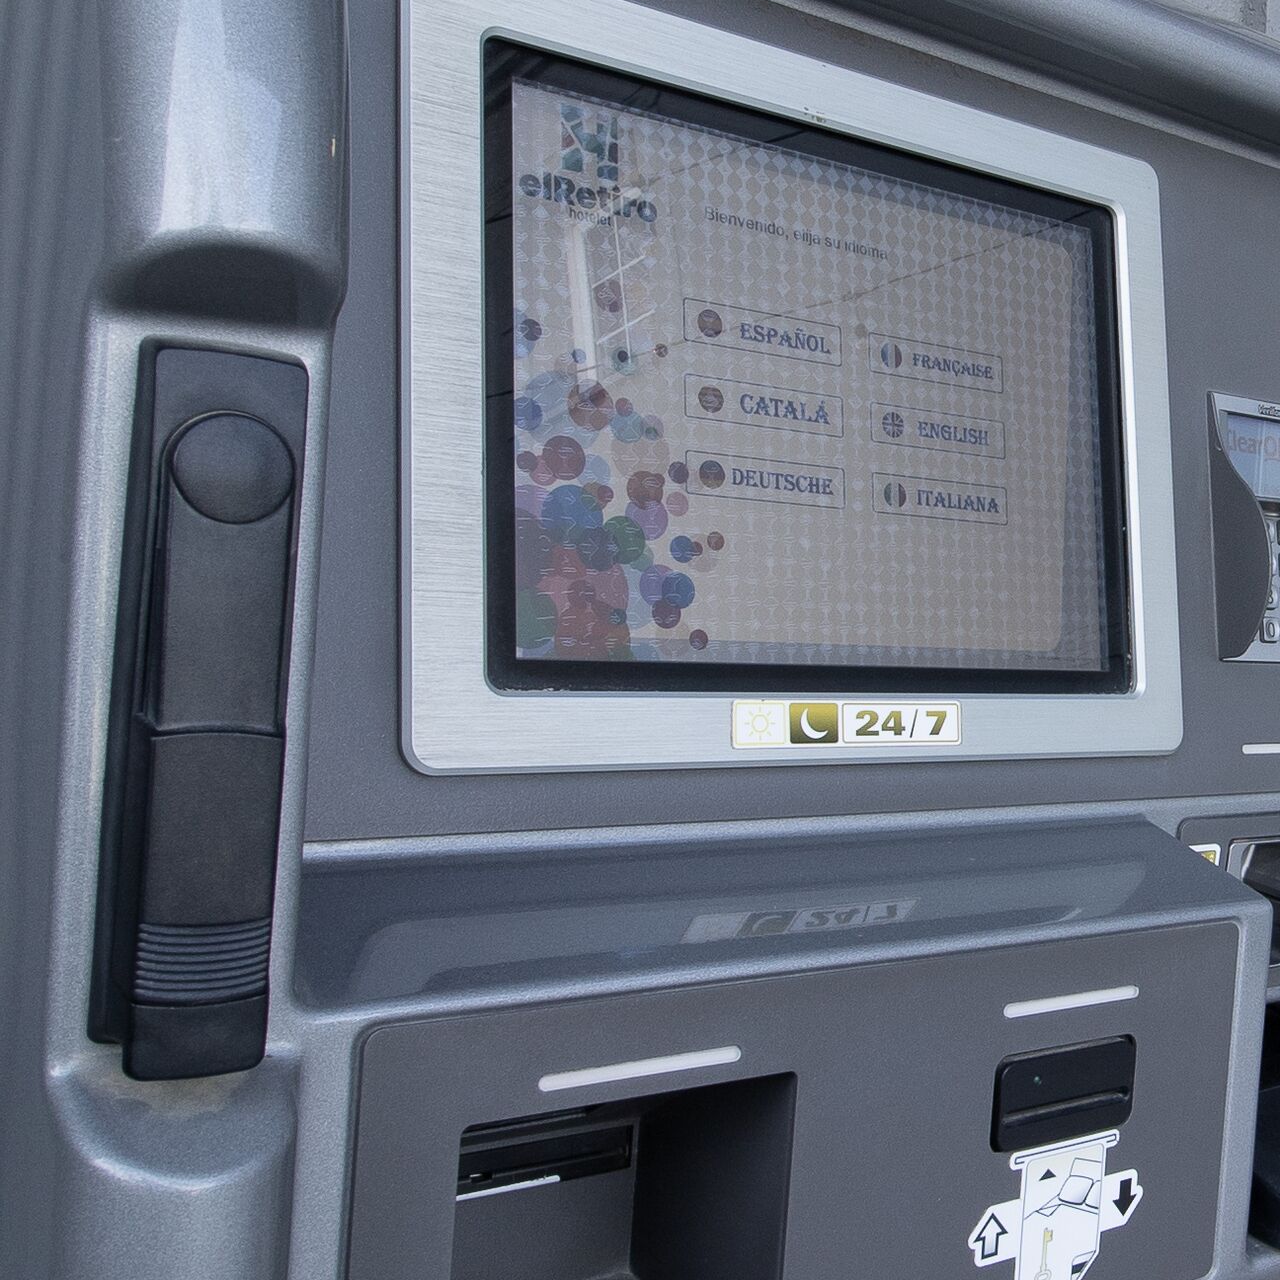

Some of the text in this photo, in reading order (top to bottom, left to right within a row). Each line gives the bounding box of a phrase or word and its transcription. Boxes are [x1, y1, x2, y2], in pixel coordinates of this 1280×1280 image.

[519, 171, 658, 223] elRetiro
[704, 206, 790, 241] Bienvenido,
[824, 236, 841, 251] su
[844, 240, 888, 261] idioma
[740, 322, 831, 355] ESPAÑOL
[912, 352, 994, 381] FRANÇAISE
[917, 420, 989, 447] ENGLISH
[731, 468, 834, 496] DEUTSCHE
[916, 488, 1000, 514] ITALIANA
[855, 708, 948, 739] 24/7
